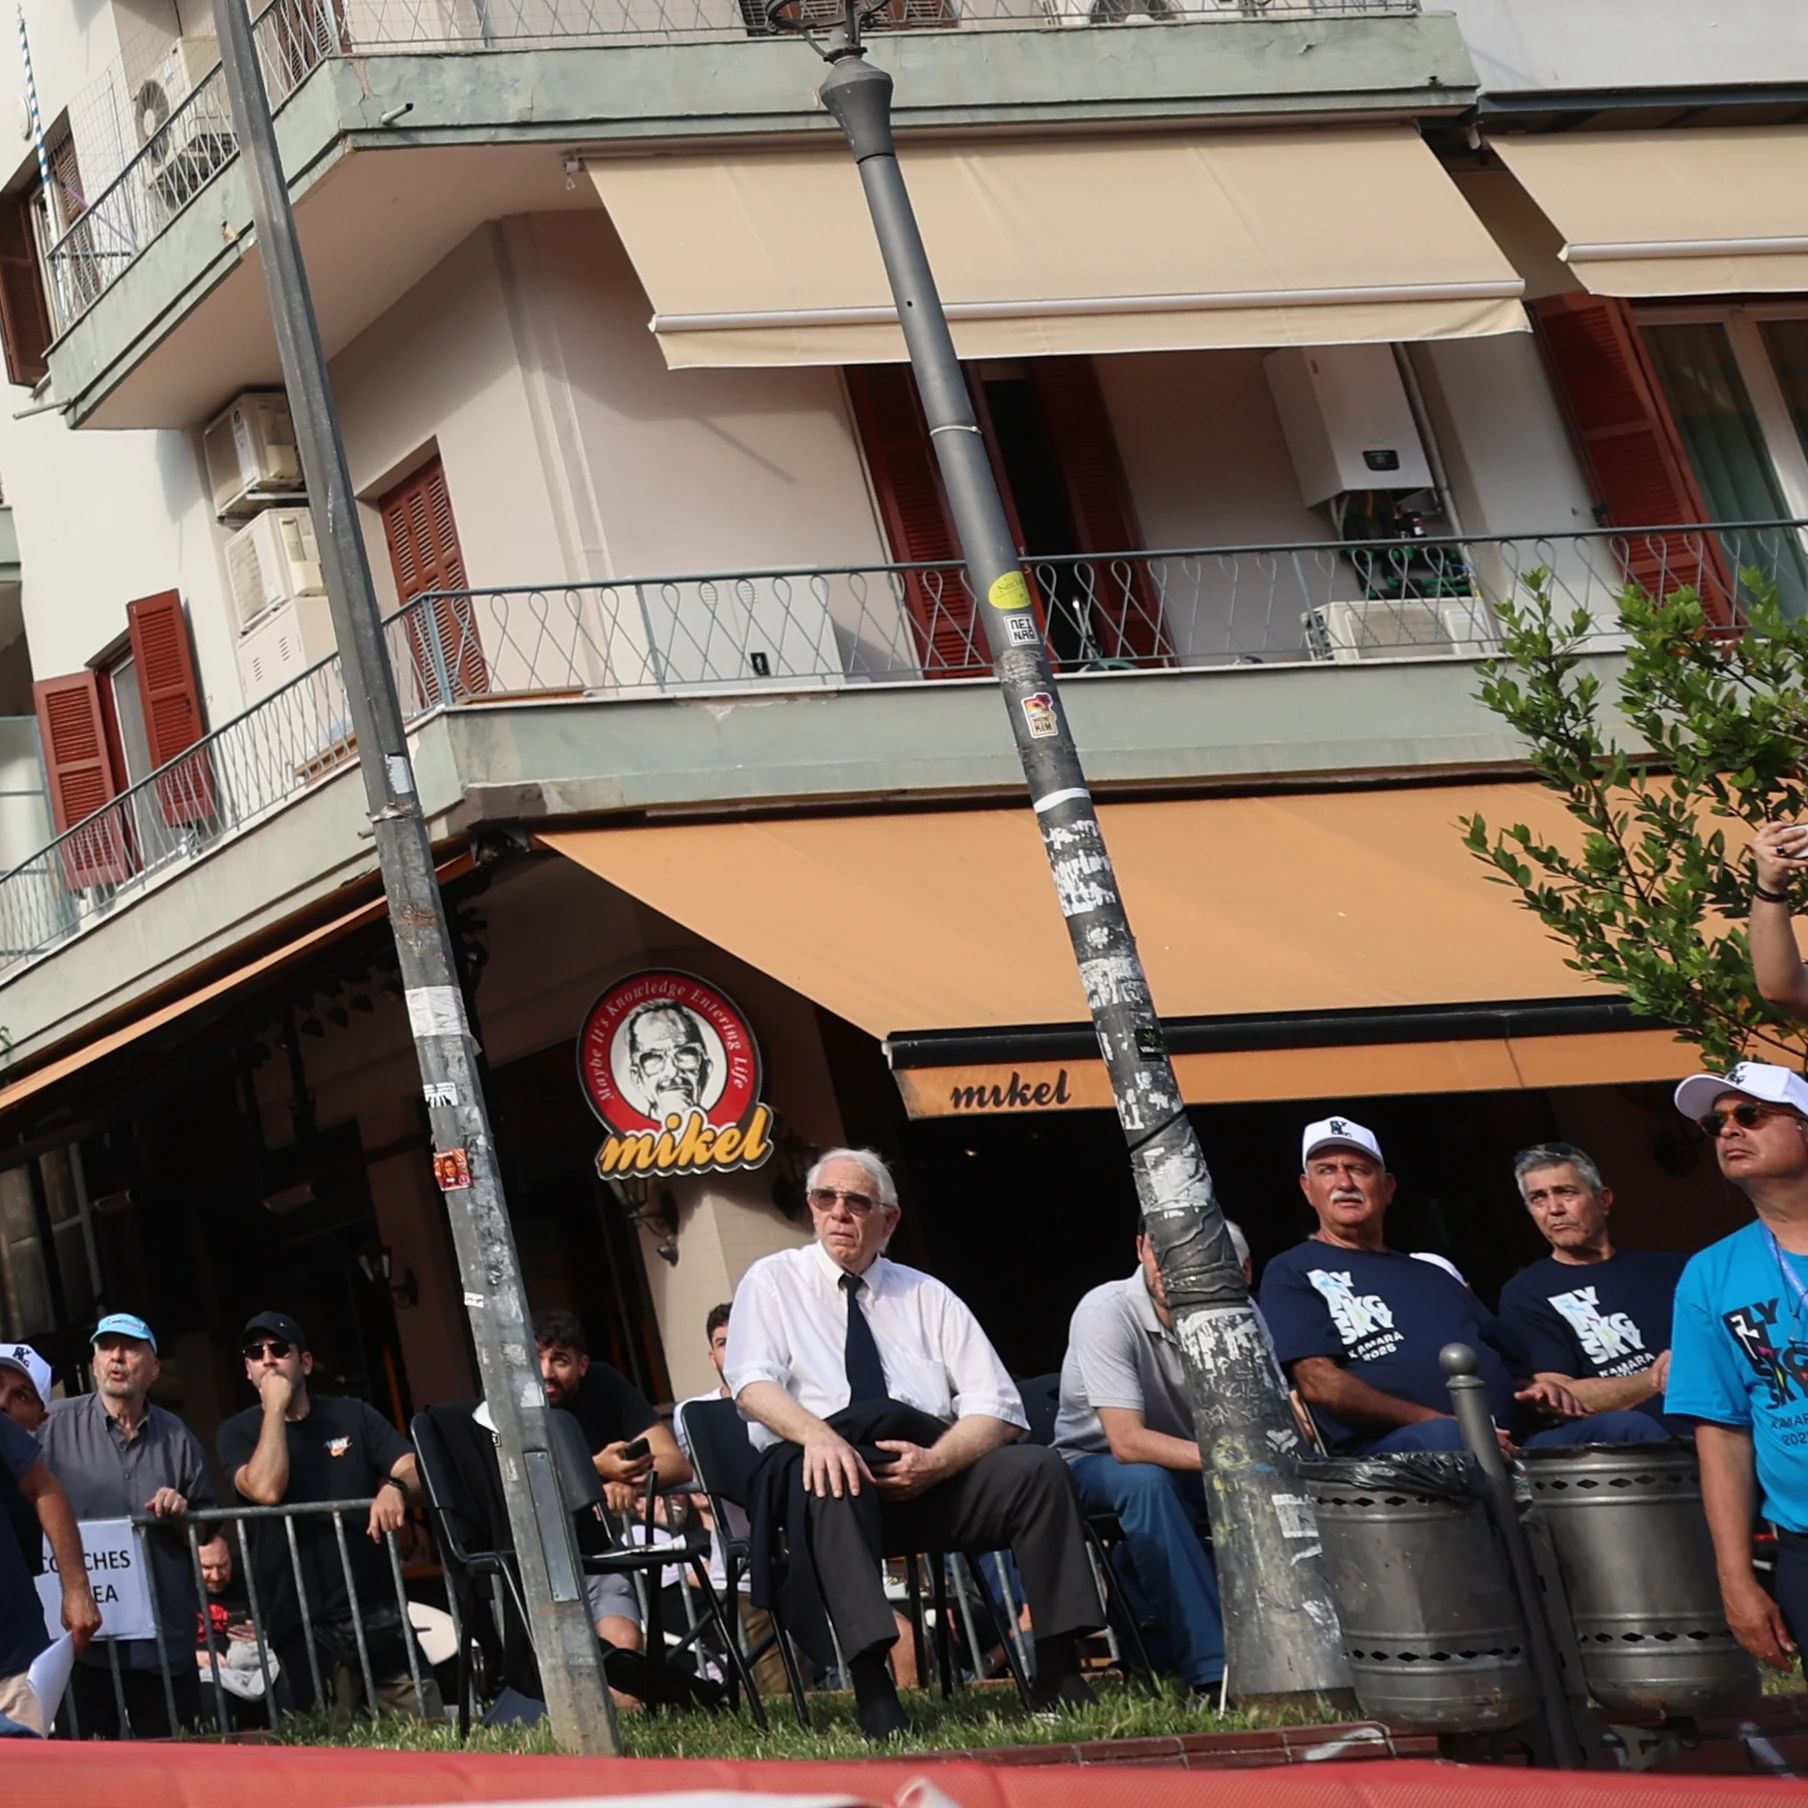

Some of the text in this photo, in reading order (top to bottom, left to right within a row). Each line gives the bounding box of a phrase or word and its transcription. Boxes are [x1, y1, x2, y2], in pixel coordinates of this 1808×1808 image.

[589, 1048, 615, 1101] Maybe
[605, 979, 686, 1017] Knowledge
[690, 988, 742, 1051] Entering
[731, 1055, 749, 1090] Life
[599, 1105, 770, 1173] mikel
[1347, 1331, 1405, 1359] KAMARA
[1598, 1352, 1656, 1379] KAMARA
[41, 1550, 131, 1573] COCHES
